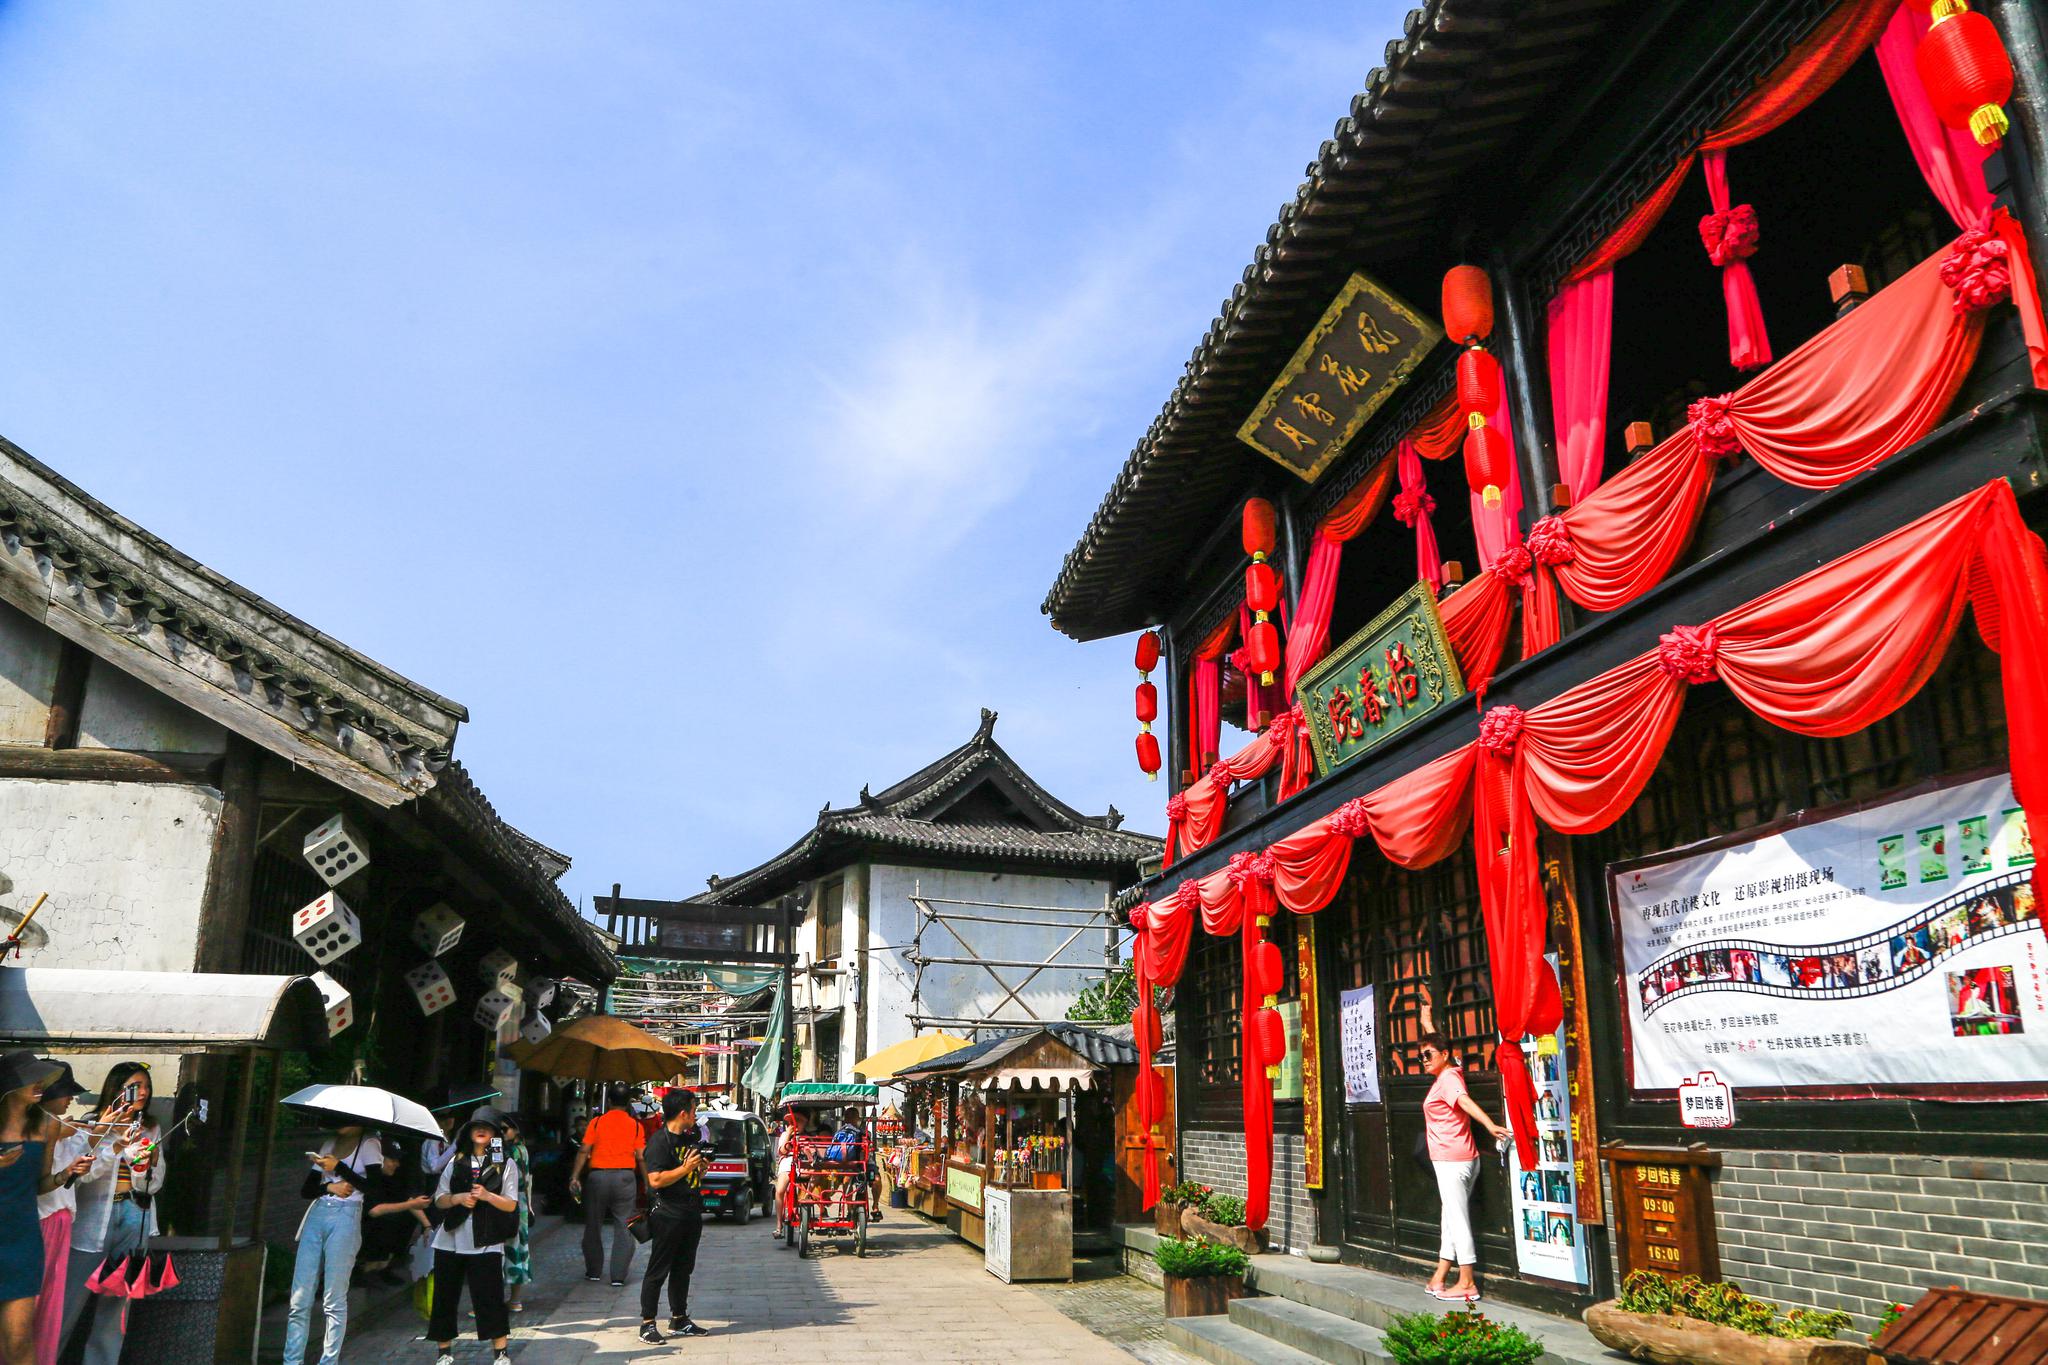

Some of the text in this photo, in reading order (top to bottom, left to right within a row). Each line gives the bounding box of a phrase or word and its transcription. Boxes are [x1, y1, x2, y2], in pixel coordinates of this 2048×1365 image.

[1733, 865, 1835, 903] 还原影视拍摄现场
[1685, 1095, 1724, 1111] 梦回怡春
[1637, 1166, 1680, 1185] 梦回怡春
[1643, 1197, 1675, 1214] 09:00
[1648, 1245, 1680, 1261] 16:00
